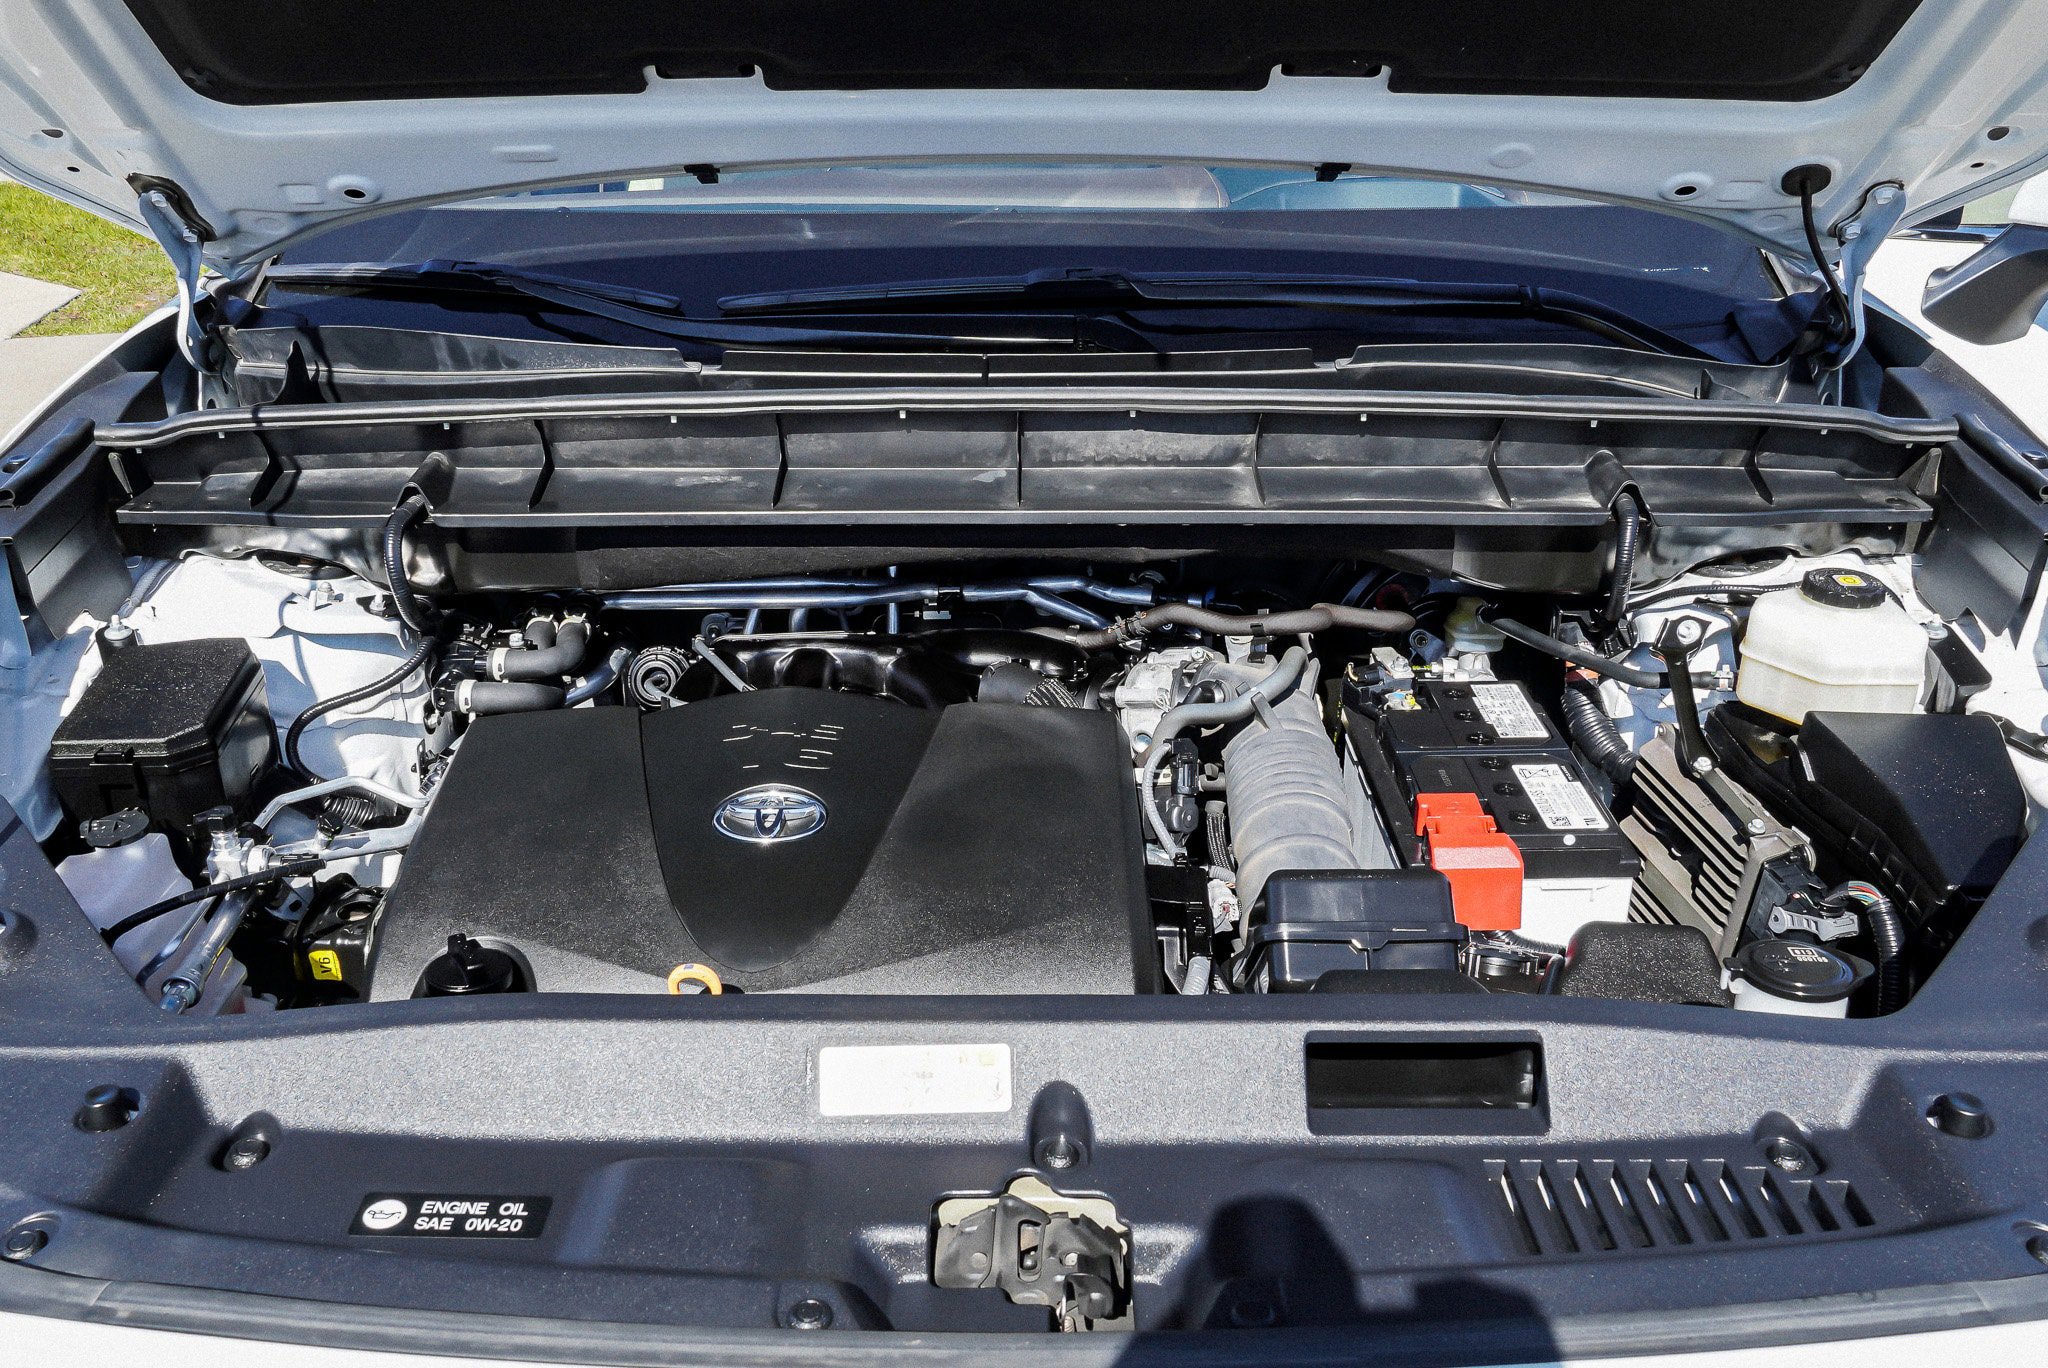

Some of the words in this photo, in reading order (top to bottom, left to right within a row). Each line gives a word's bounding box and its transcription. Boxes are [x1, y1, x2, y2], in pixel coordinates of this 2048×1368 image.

[319, 957, 332, 974] V6
[420, 1201, 489, 1214] ENGINE
[499, 1202, 528, 1215] OIL
[413, 1217, 454, 1230] SAE
[464, 1218, 523, 1231] 0W-20
